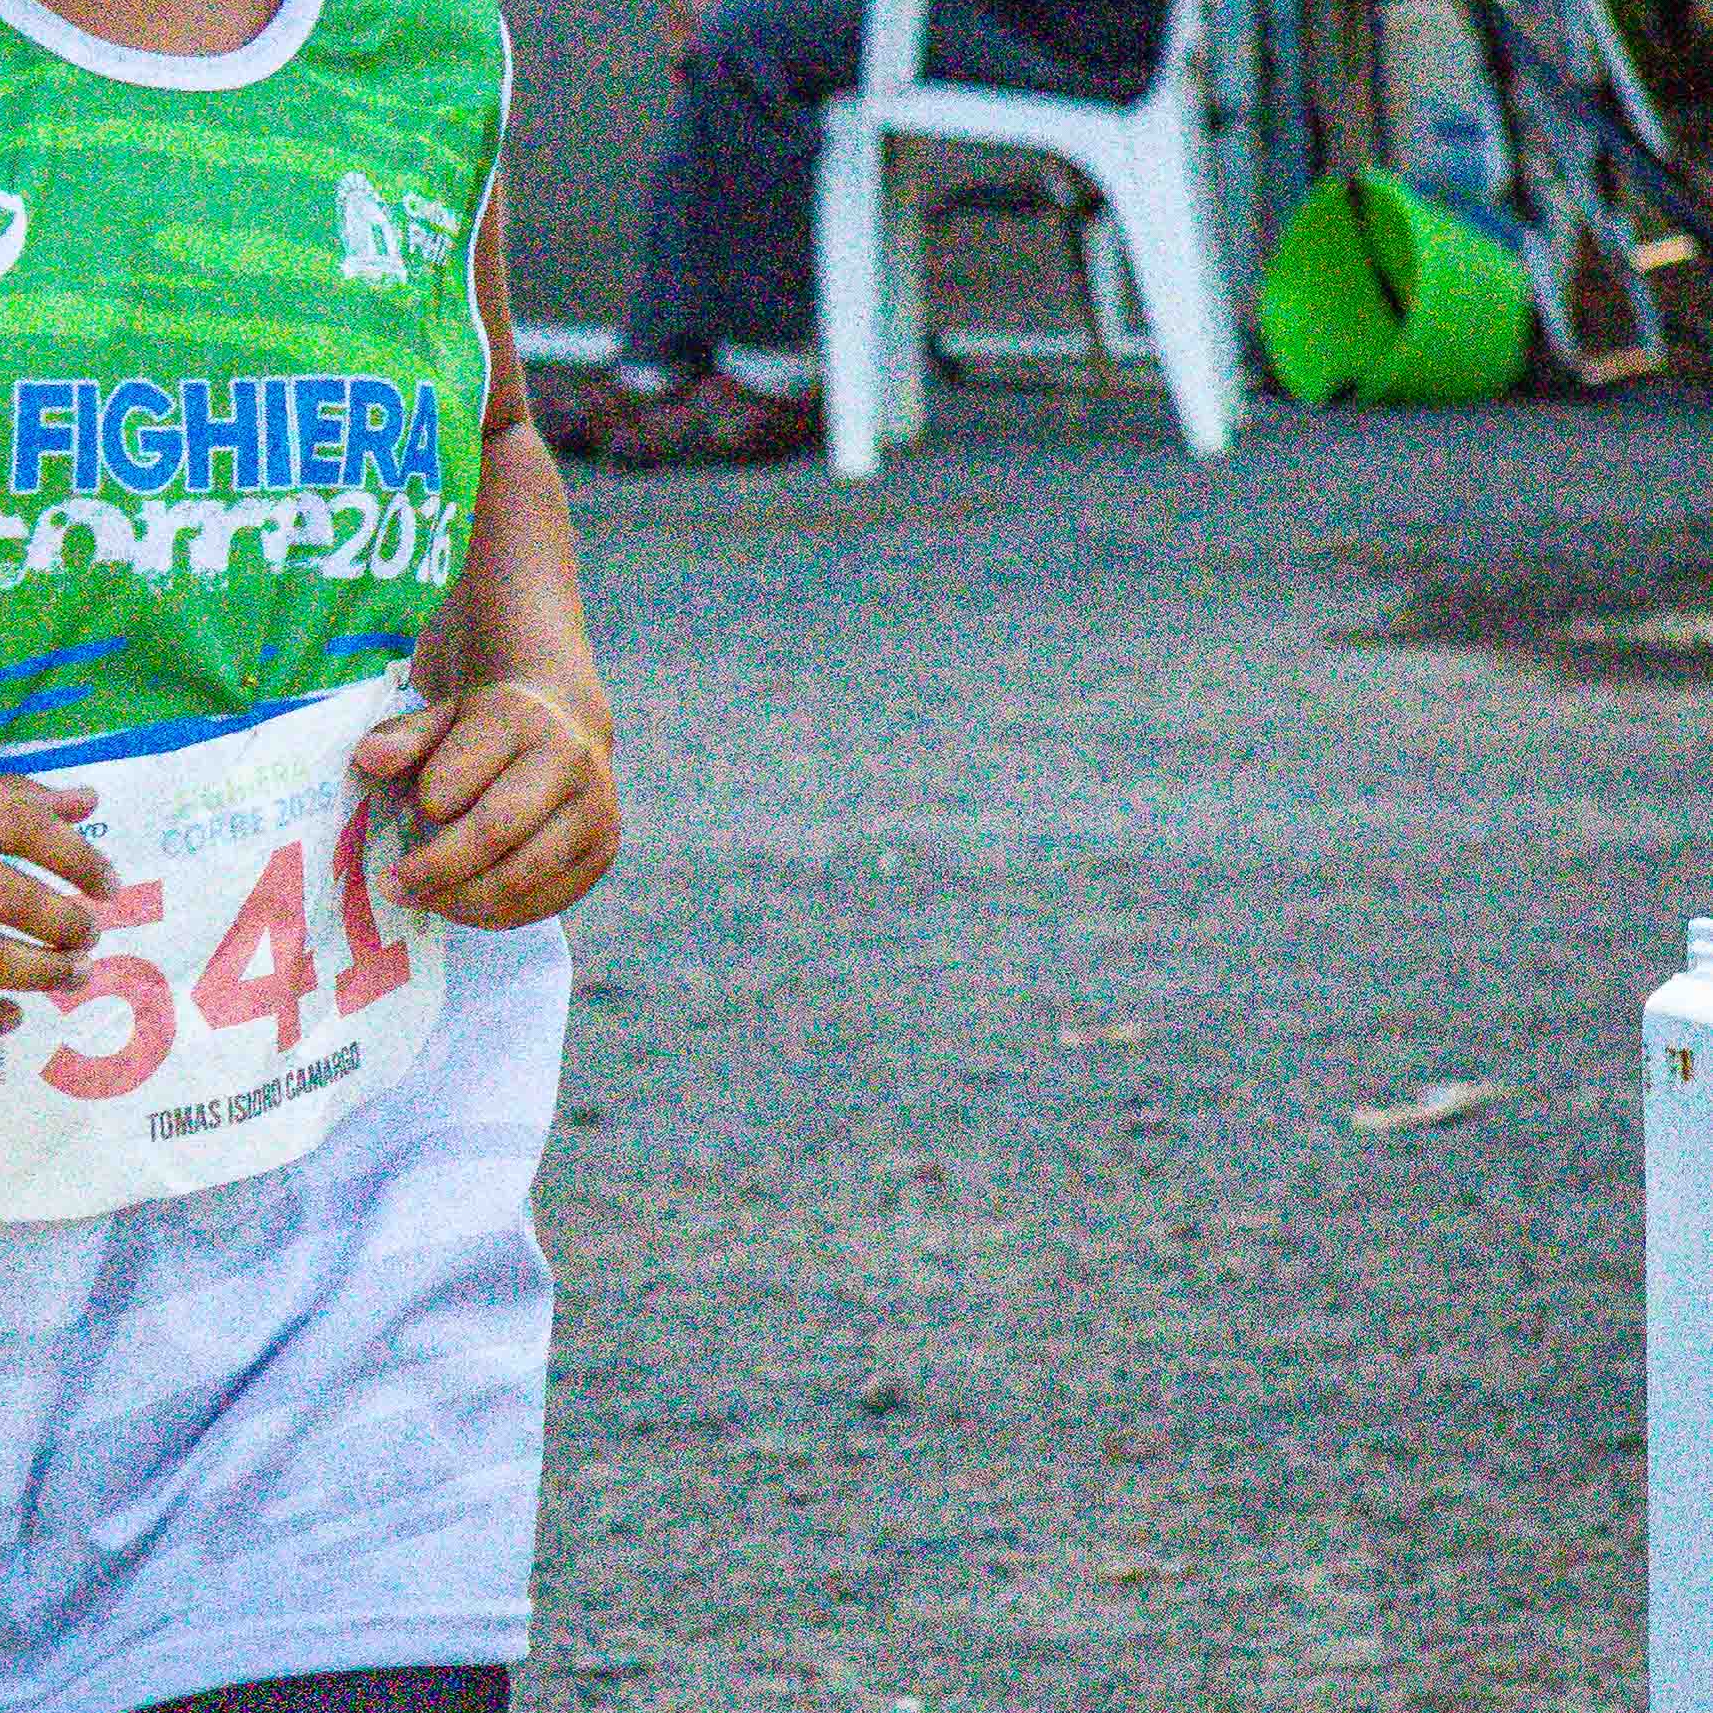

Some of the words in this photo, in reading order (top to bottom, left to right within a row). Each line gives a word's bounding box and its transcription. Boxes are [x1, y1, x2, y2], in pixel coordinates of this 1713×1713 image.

[12, 377, 443, 494] FIGHIERA
[38, 794, 410, 1101] 541
[146, 1100, 221, 1142] TOMAS
[227, 1079, 282, 1125] ISIDRO
[285, 1042, 361, 1099] CAMARGO
